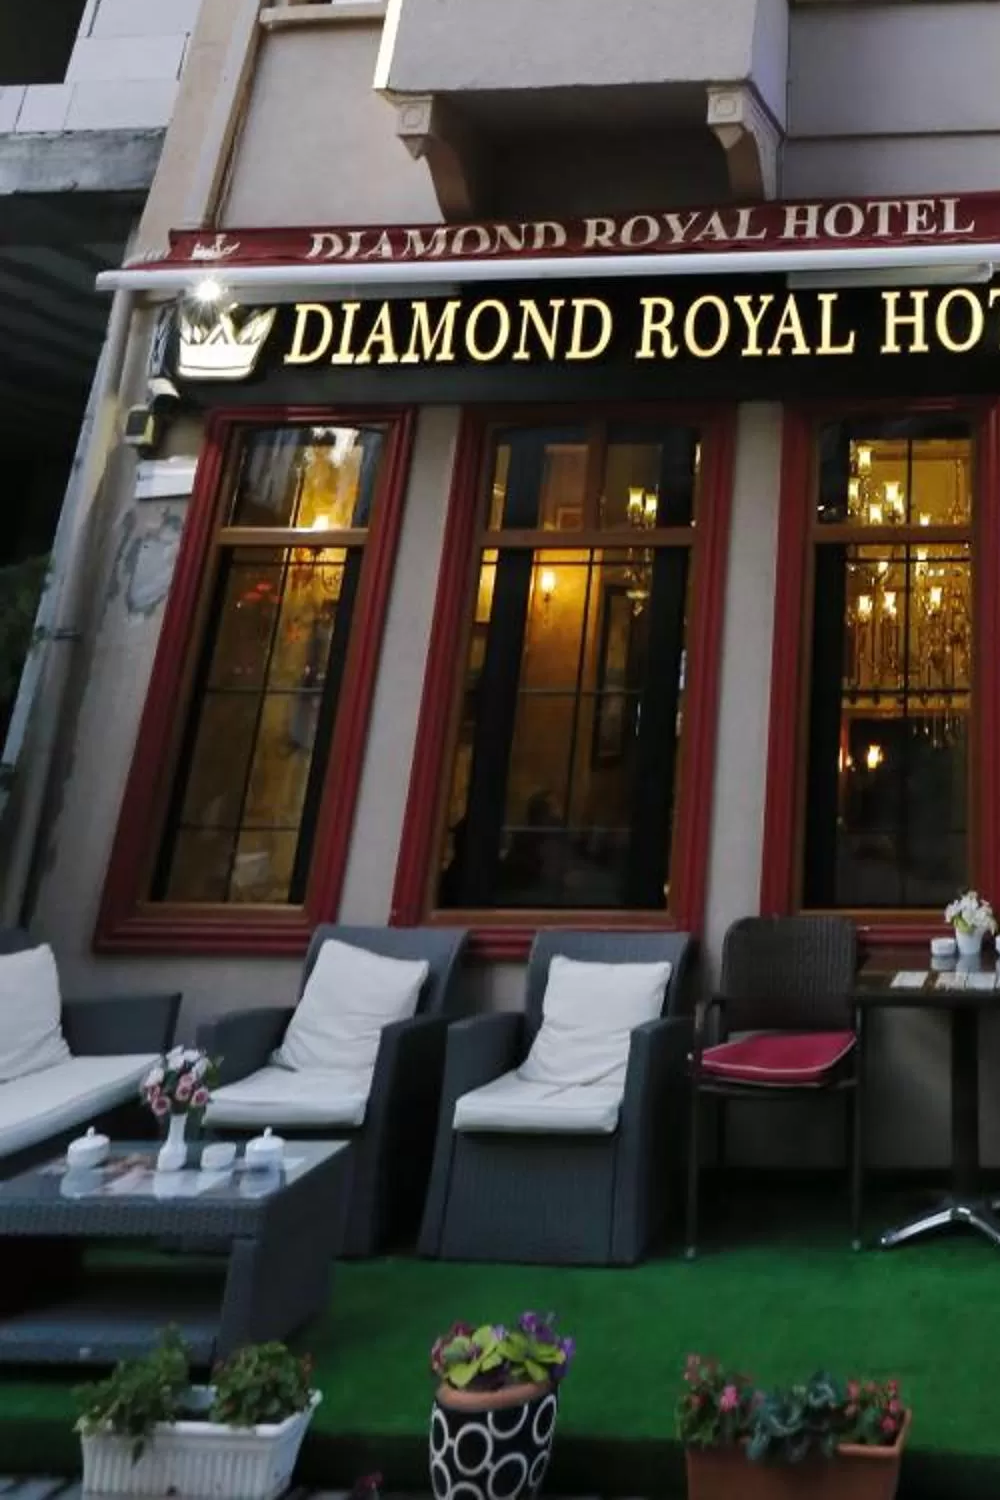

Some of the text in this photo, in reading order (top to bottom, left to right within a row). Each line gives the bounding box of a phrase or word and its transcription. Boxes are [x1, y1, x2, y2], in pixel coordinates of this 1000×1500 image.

[305, 198, 975, 260] DIAMOND ROYAL HOTEL
[283, 297, 614, 366] DIAMOND
[634, 292, 856, 359] ROYAL
